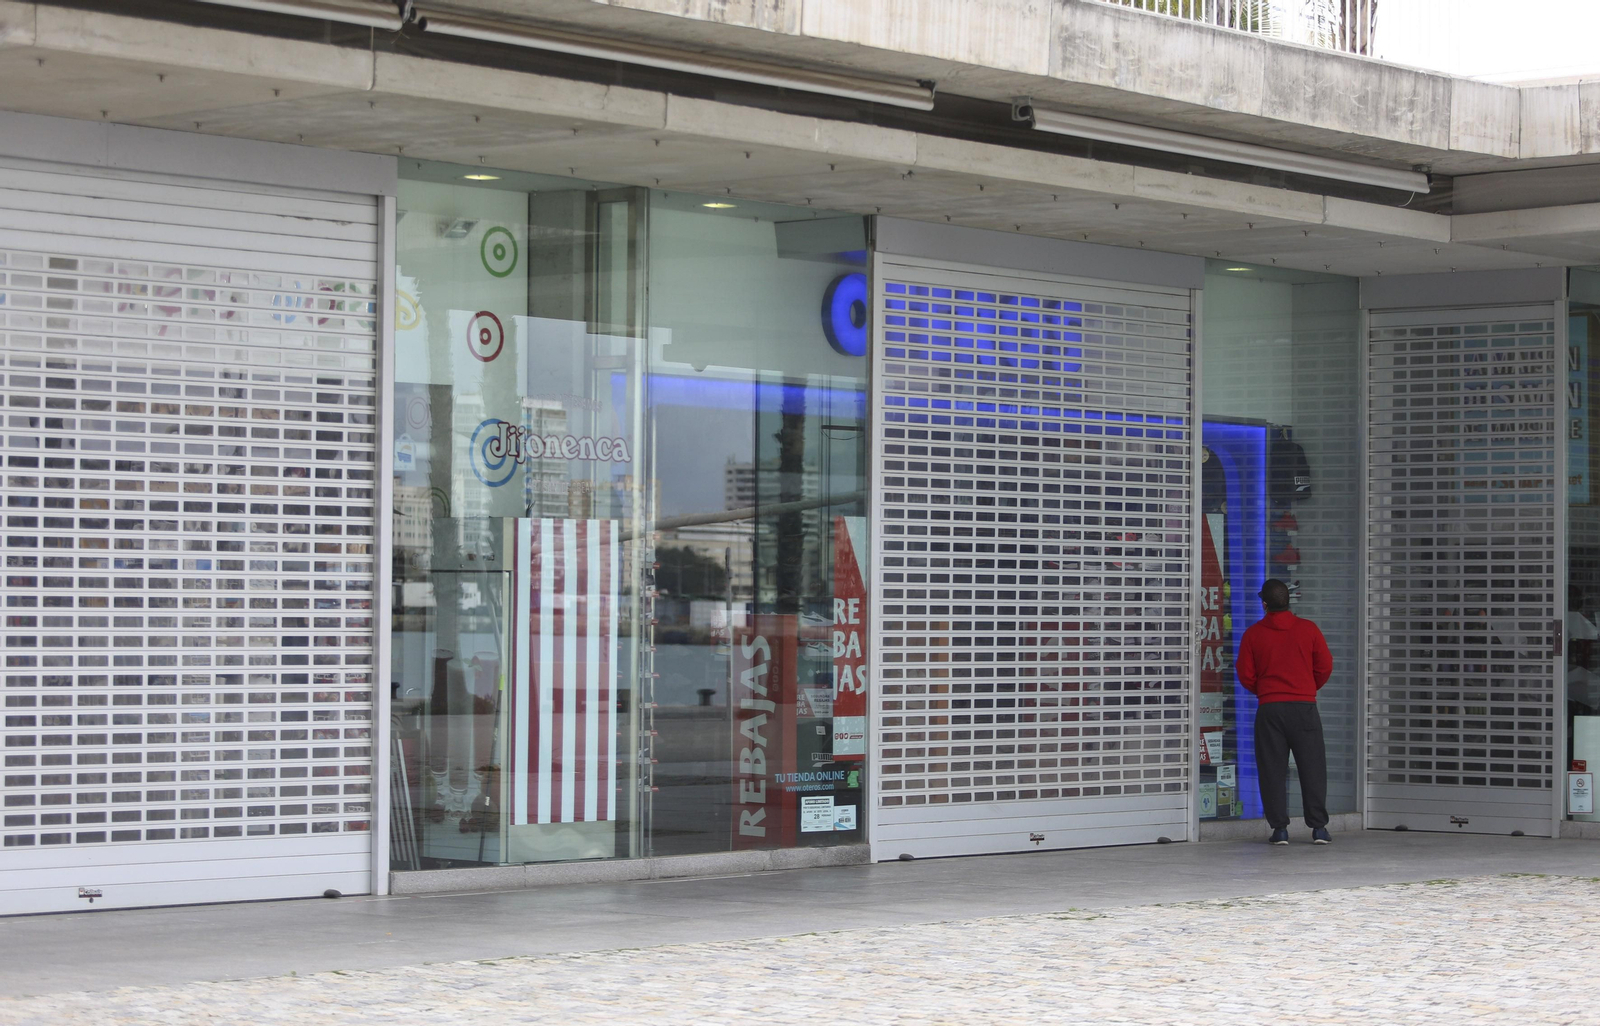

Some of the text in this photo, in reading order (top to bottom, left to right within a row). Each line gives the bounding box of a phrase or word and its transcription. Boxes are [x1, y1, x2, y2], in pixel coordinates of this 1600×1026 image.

[1491, 346, 1580, 375] MAISN
[1498, 382, 1581, 411] SAVN
[490, 421, 631, 464] Jijonenca
[833, 598, 861, 626] RE
[833, 629, 862, 658] BA
[1201, 646, 1225, 673] AS
[833, 664, 866, 701] JAS
[739, 634, 776, 838] REBAJAS
[775, 770, 845, 783] TU TIENDA ONLINE
[785, 783, 835, 792] www.oteros.com
